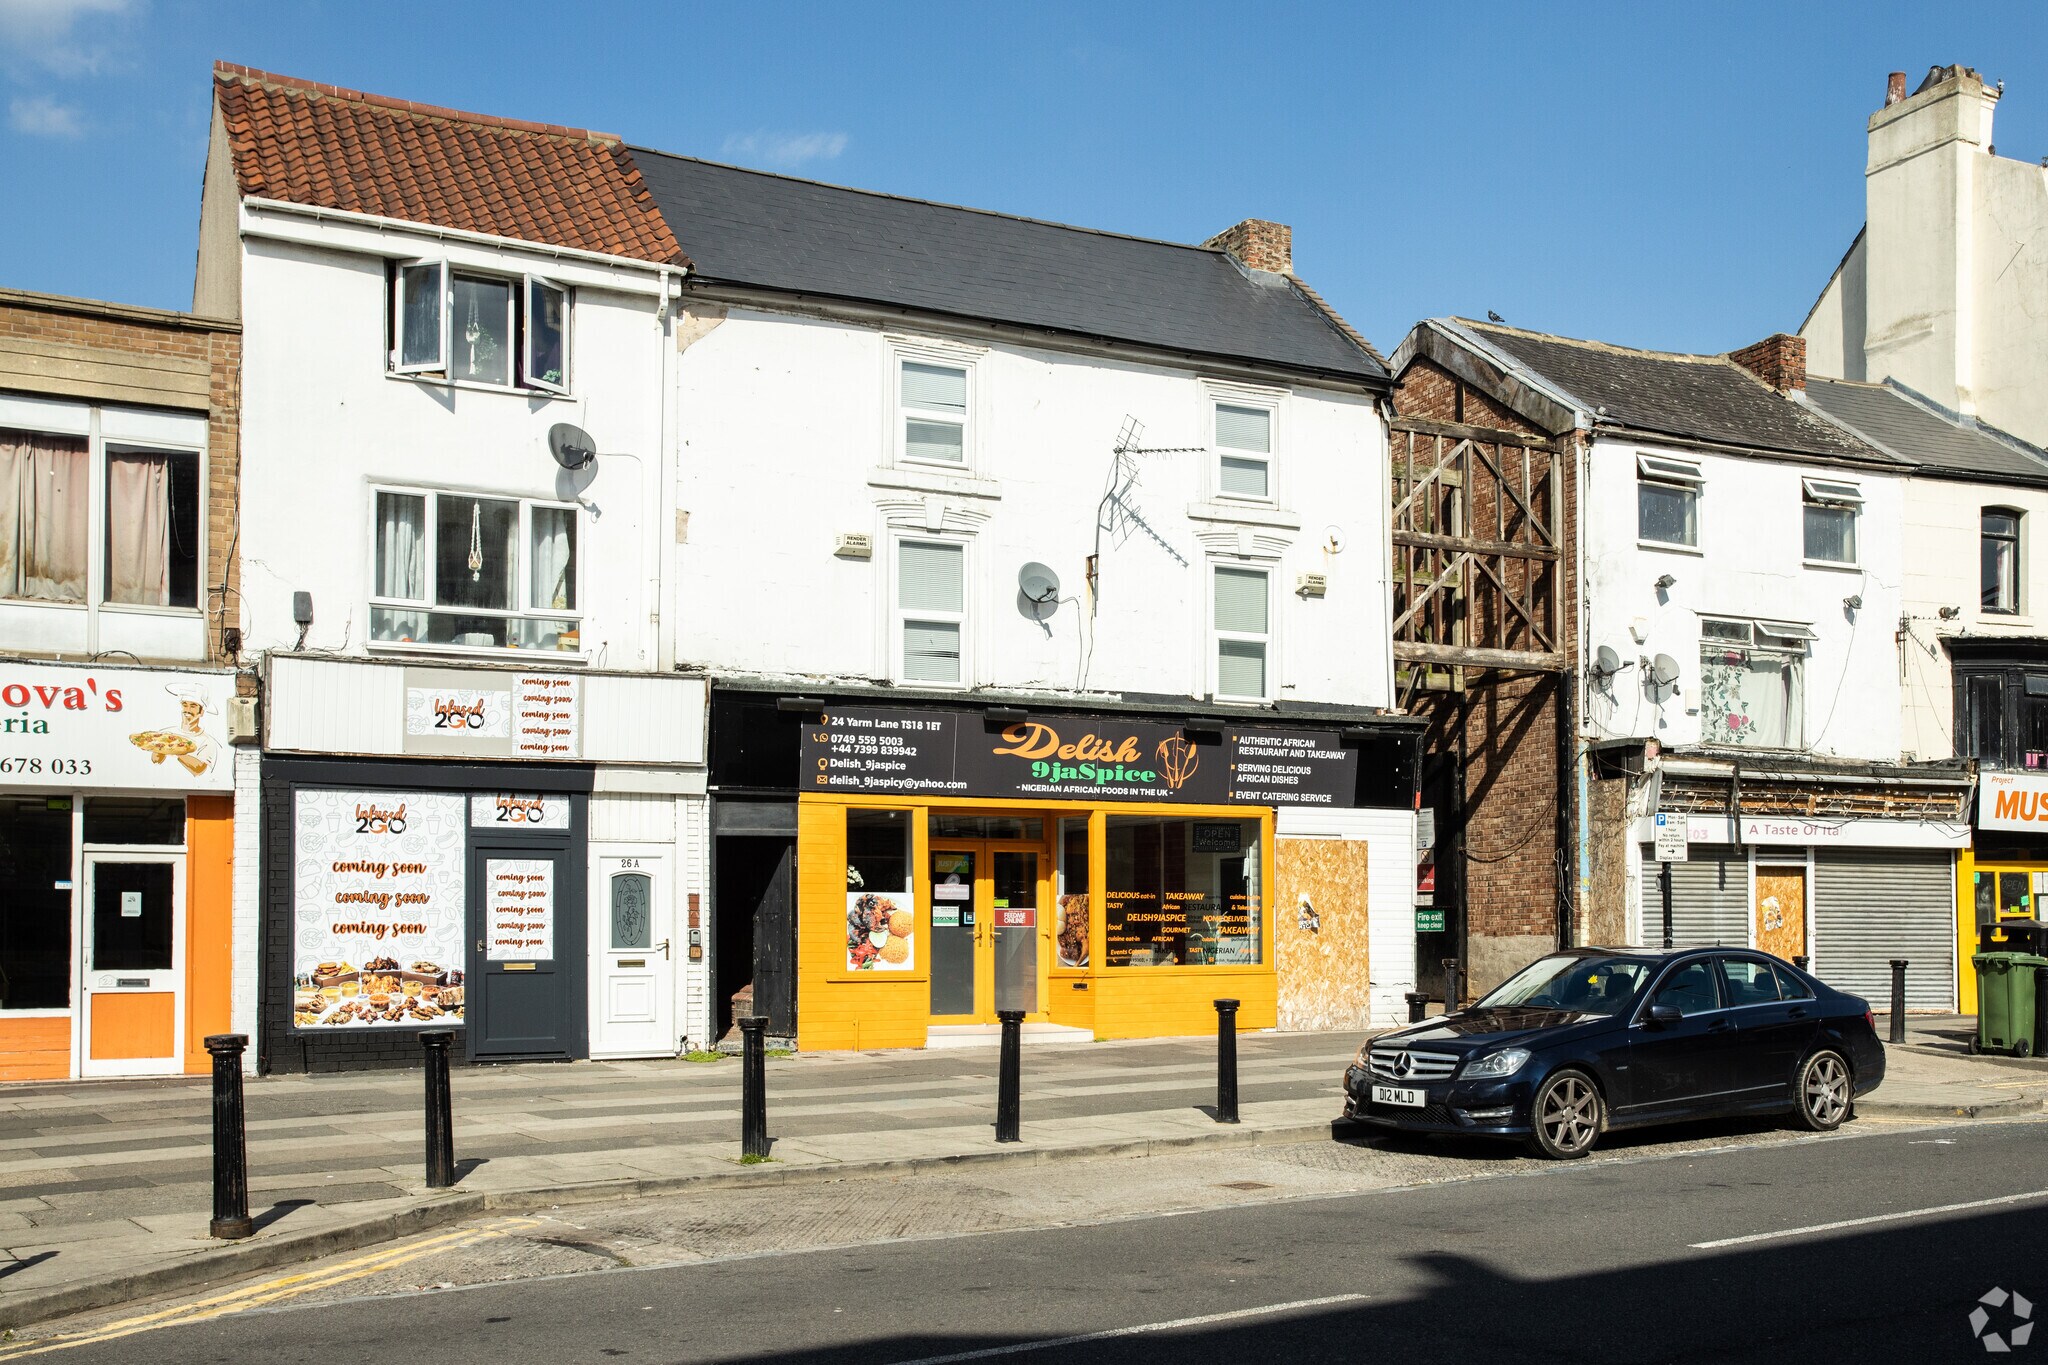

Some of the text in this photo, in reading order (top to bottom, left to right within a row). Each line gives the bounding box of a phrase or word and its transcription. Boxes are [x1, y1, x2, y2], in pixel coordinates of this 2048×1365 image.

[522, 678, 551, 689] coming
[2, 678, 123, 712] ova's
[523, 695, 572, 705] coming soon
[435, 698, 485, 716] Infused
[522, 711, 570, 721] coming soon
[0, 712, 50, 734] ria
[832, 717, 941, 731] 24 Yarm Lane TS18 1ET
[522, 727, 552, 737] coming
[831, 734, 903, 745] 0749 559 5003
[993, 722, 1142, 762] Delish
[1239, 736, 1315, 748] AUTHENTIC AFRICAN
[521, 743, 550, 754] coming
[831, 745, 916, 756] +44 7399 839942
[1239, 747, 1346, 759] RESTAURANT AND TAKEAWAY
[0, 758, 92, 775] 678 033
[830, 758, 906, 771] Delish_9jaspice
[1238, 764, 1311, 775] SERVING DELICIOUS
[1032, 762, 1156, 785] 9jaSpice
[1237, 774, 1298, 784] AFRICAN DISHES
[830, 775, 967, 789] delish_9jaspicy@yahoo.com
[1992, 776, 2014, 786] Project
[1022, 784, 1062, 792] NIGERIAN
[1063, 785, 1100, 794] AFRICAN
[496, 793, 544, 810] Infused
[1236, 791, 1332, 802] EVENT CATERING SERVICE
[356, 804, 407, 822] Infused
[1204, 830, 1230, 838] OPEN
[1749, 825, 1758, 834] A
[1764, 825, 1798, 835] Taste
[1803, 825, 1818, 835] Of
[621, 859, 631, 868] 26
[333, 860, 427, 879] coming soon
[496, 874, 525, 884] coming
[335, 890, 430, 910] coming soon
[498, 890, 527, 900] coming
[496, 906, 526, 916] coming
[1418, 913, 1430, 921] Fire
[333, 922, 427, 940] coming soon
[497, 922, 526, 932] coming
[496, 938, 544, 948] coming soon
[1380, 1088, 1414, 1104] D12 MLD
